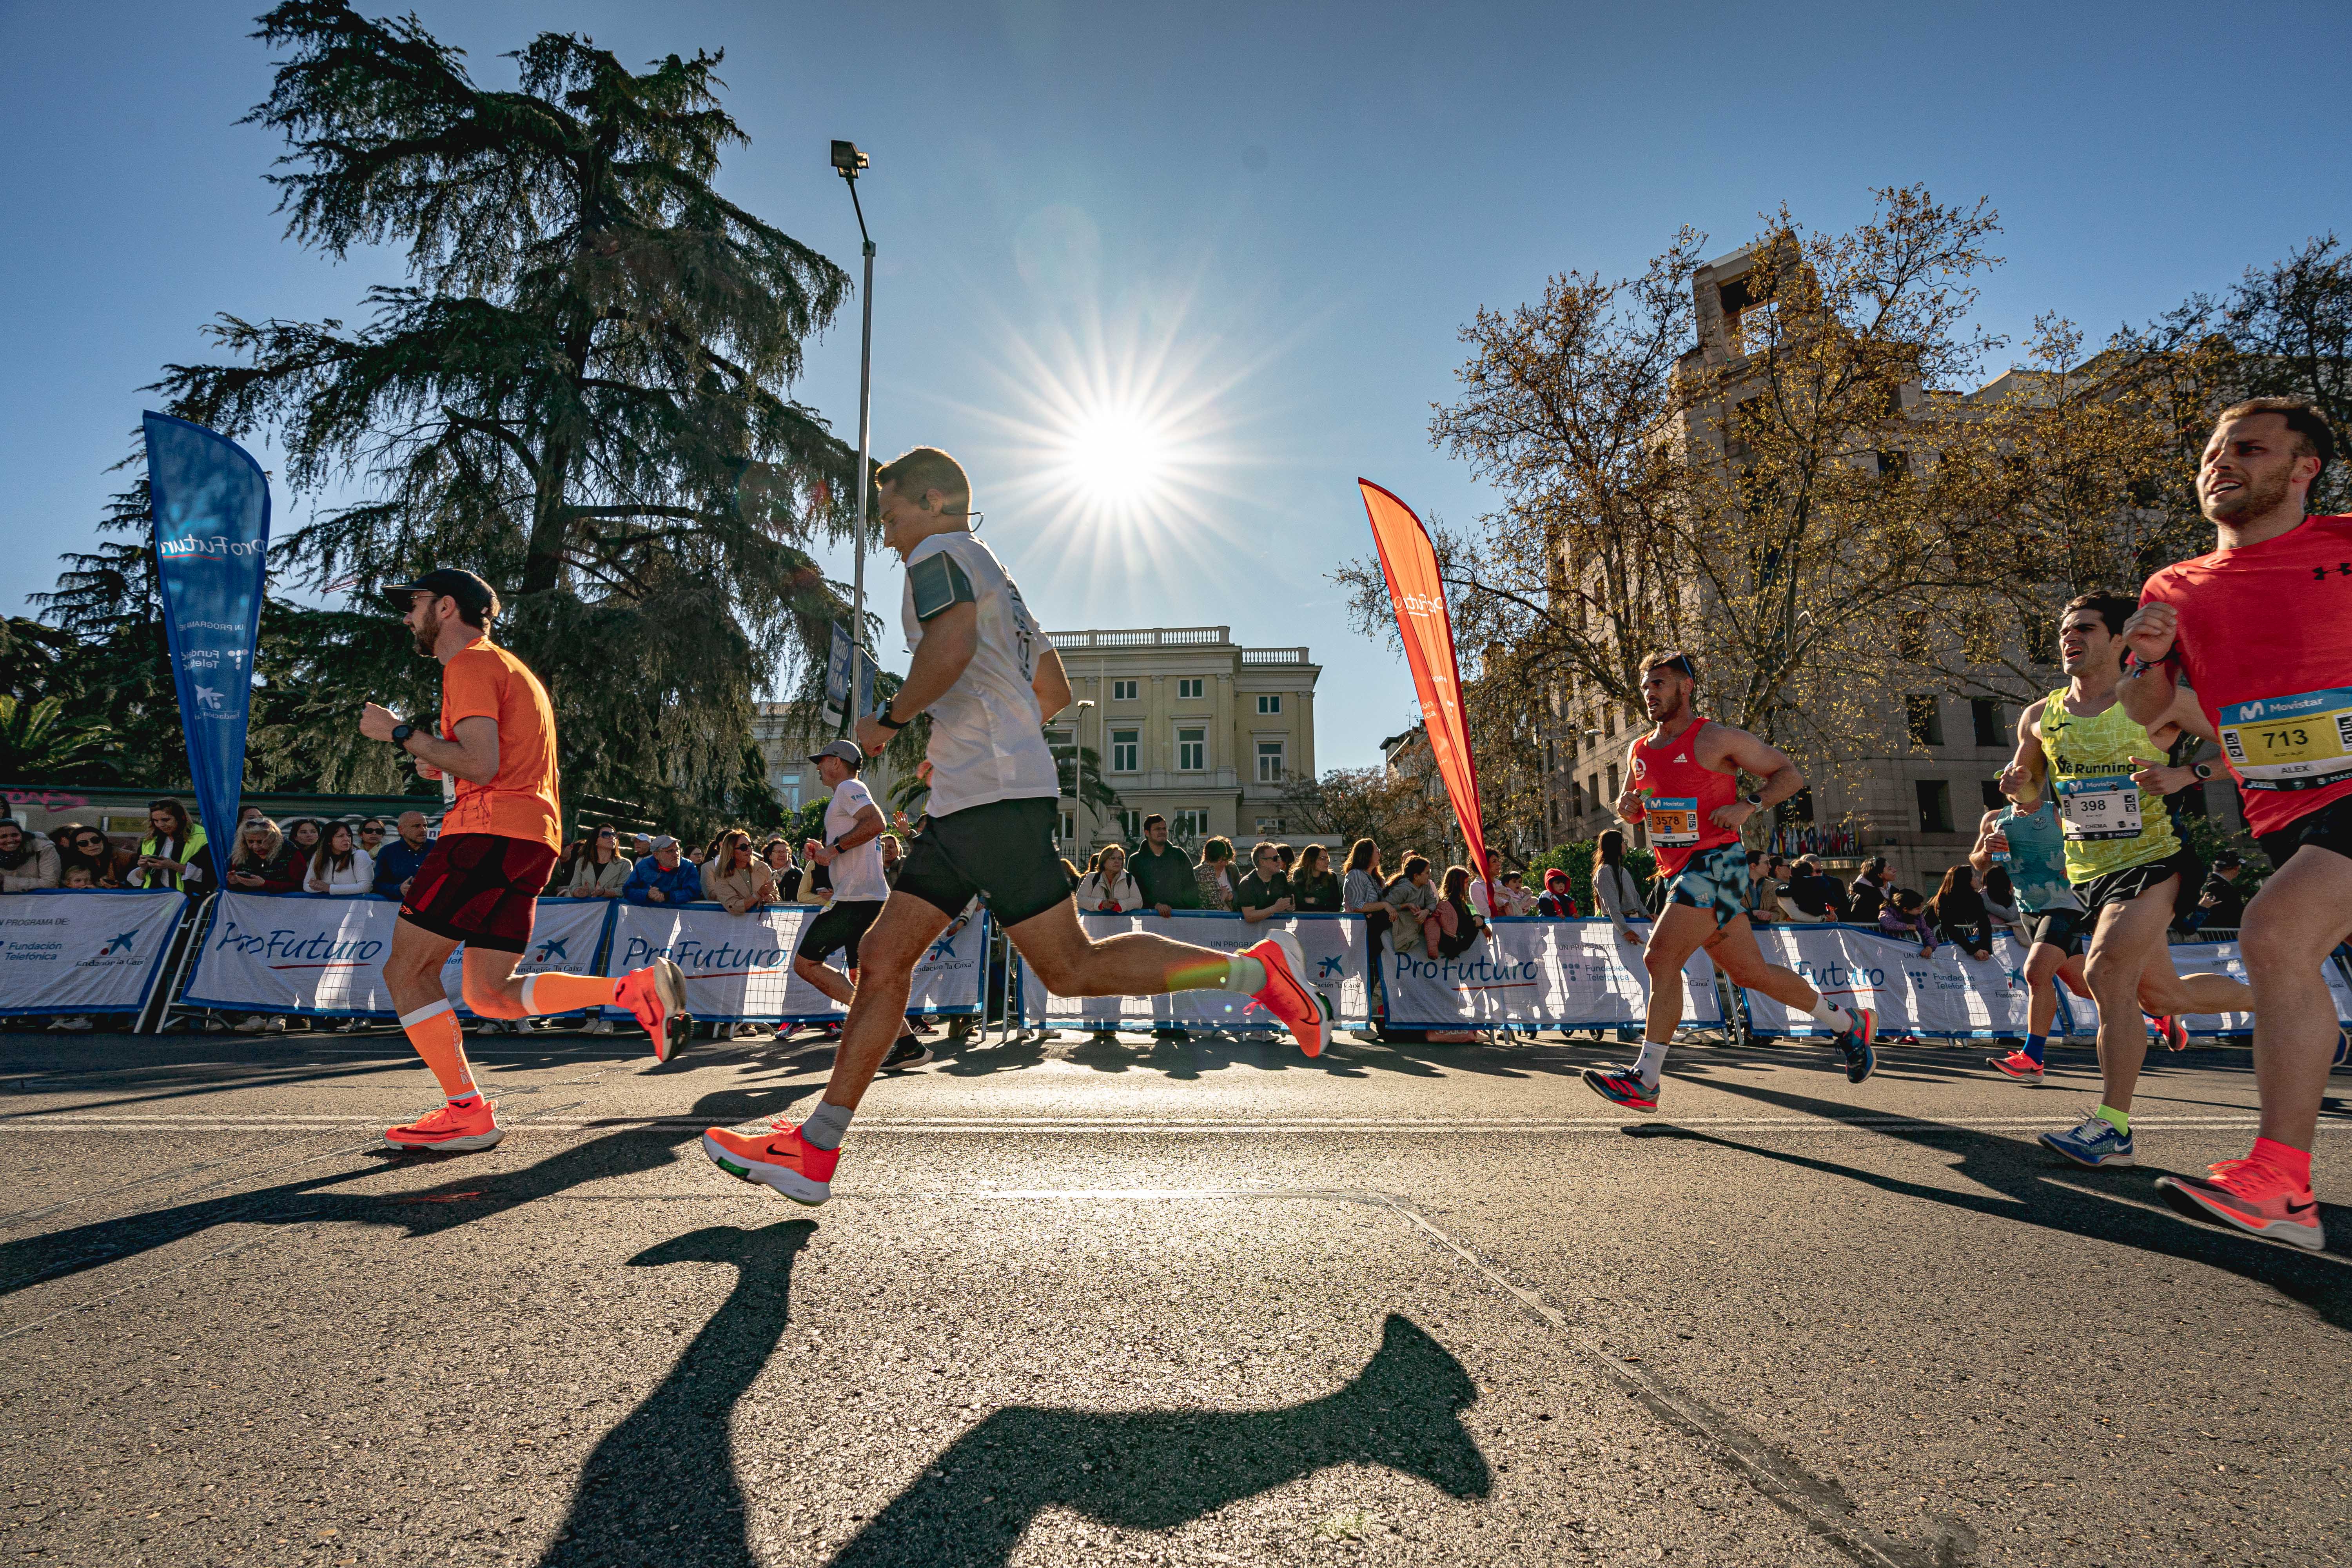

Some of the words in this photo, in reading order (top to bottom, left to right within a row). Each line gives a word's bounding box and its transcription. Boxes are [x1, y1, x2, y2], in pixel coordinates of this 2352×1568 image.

[2270, 699, 2323, 712] Movistar
[2262, 729, 2308, 748] 713
[2075, 763, 2136, 774] Running
[2281, 765, 2310, 774] ALEX
[2081, 800, 2106, 811] 398
[1656, 816, 1679, 825] 3578
[9, 942, 62, 950] Fundación
[216, 922, 383, 960] ProFuturo
[5, 951, 57, 960] Telefónica
[622, 937, 787, 968] ProFuturo
[913, 964, 943, 973] undación
[1394, 951, 1538, 981] ProFuturo
[1585, 964, 1628, 972] Fundación
[1794, 960, 1885, 987] Futuro
